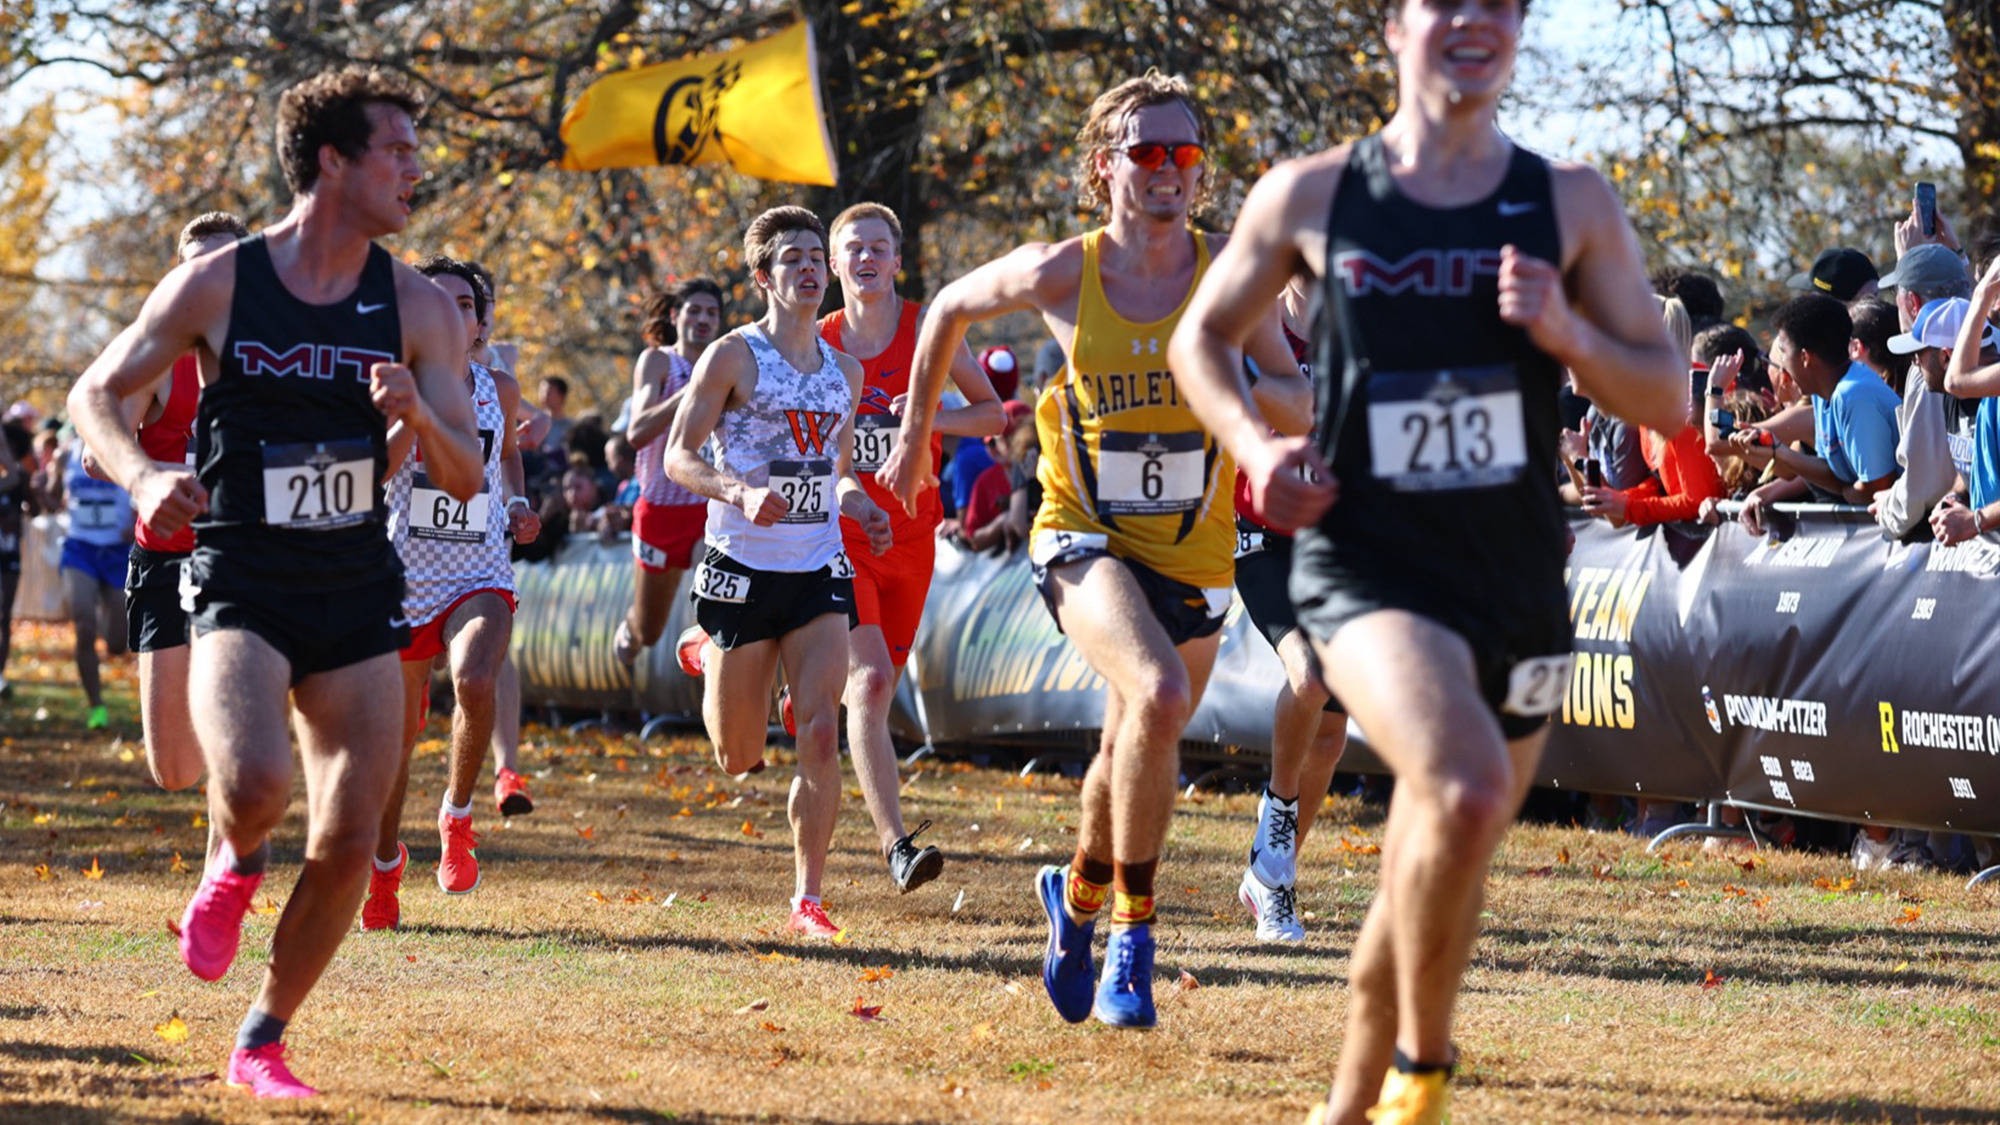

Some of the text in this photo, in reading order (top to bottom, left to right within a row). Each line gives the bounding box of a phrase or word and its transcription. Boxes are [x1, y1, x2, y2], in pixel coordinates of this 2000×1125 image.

[234, 341, 394, 383] MIT
[783, 410, 842, 456] W
[1403, 407, 1494, 473] 213
[288, 469, 354, 520] 210
[781, 481, 822, 513] 325
[1141, 459, 1163, 500] 6
[432, 496, 469, 530] 64
[700, 567, 739, 600] 325
[1569, 567, 1652, 642] TEAM
[1776, 592, 1801, 613] 1973
[1879, 702, 1899, 753] R
[1902, 710, 1985, 752] ROCHESTER
[1949, 777, 1976, 799] 1991
